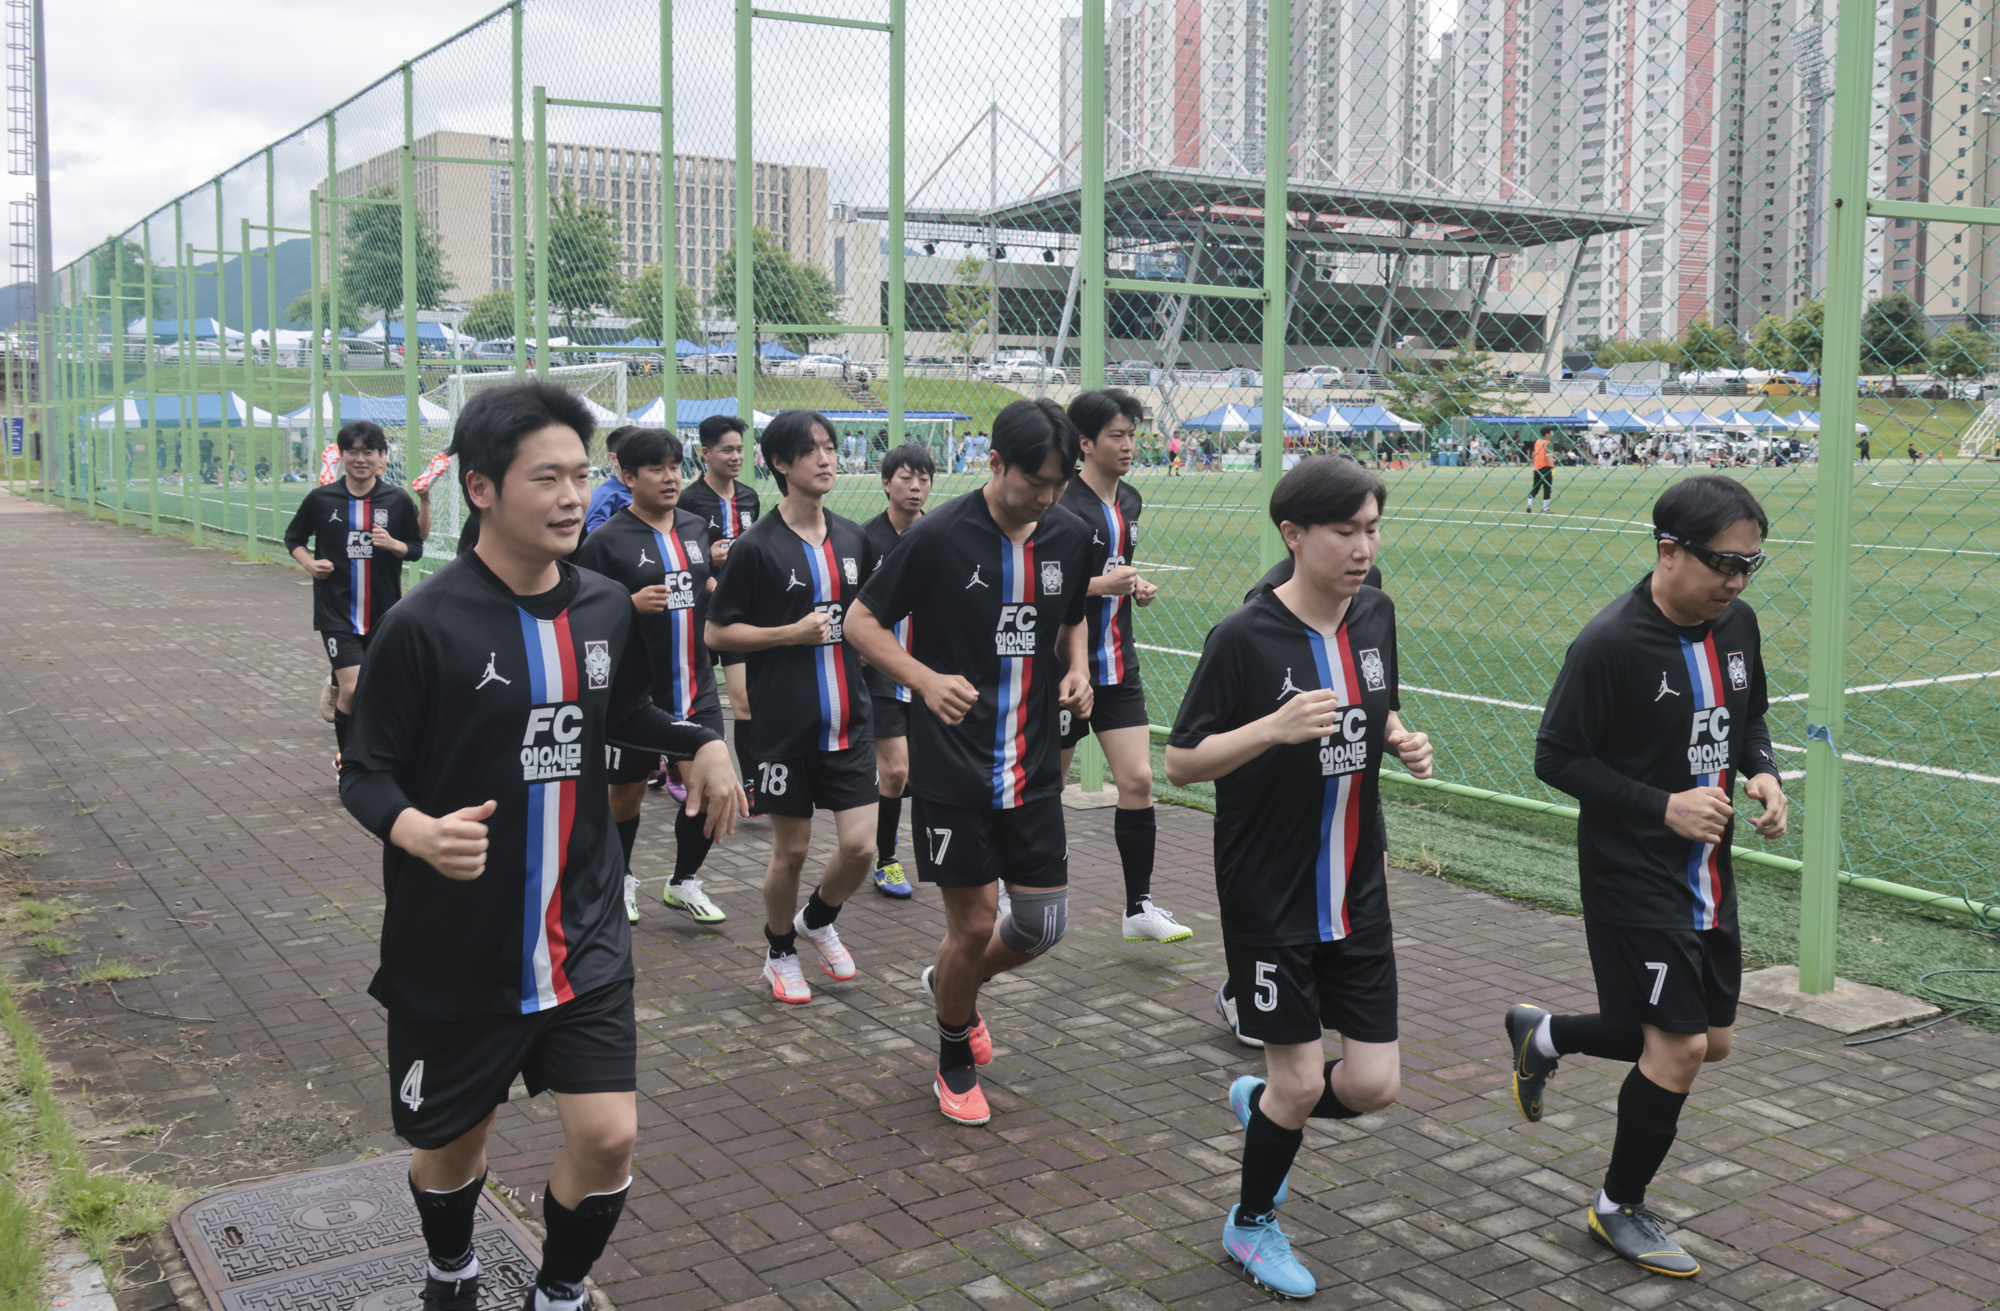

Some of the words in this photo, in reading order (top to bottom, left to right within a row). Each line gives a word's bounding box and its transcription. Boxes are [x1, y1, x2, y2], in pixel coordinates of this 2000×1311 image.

[347, 531, 373, 546] FC
[664, 571, 692, 592] FC
[996, 605, 1037, 632] FC
[328, 637, 338, 657] 8
[995, 631, 1036, 656] 일요신문
[521, 704, 584, 747] FC
[1689, 706, 1731, 746] FC
[520, 743, 582, 782] 일요신문
[1319, 740, 1368, 776] 일요신문
[1687, 740, 1730, 777] 일요신문
[757, 761, 789, 796] 18
[926, 826, 953, 866] 17
[1254, 960, 1279, 1012] 5
[1644, 961, 1669, 1006] 7
[399, 1059, 425, 1112] 4
